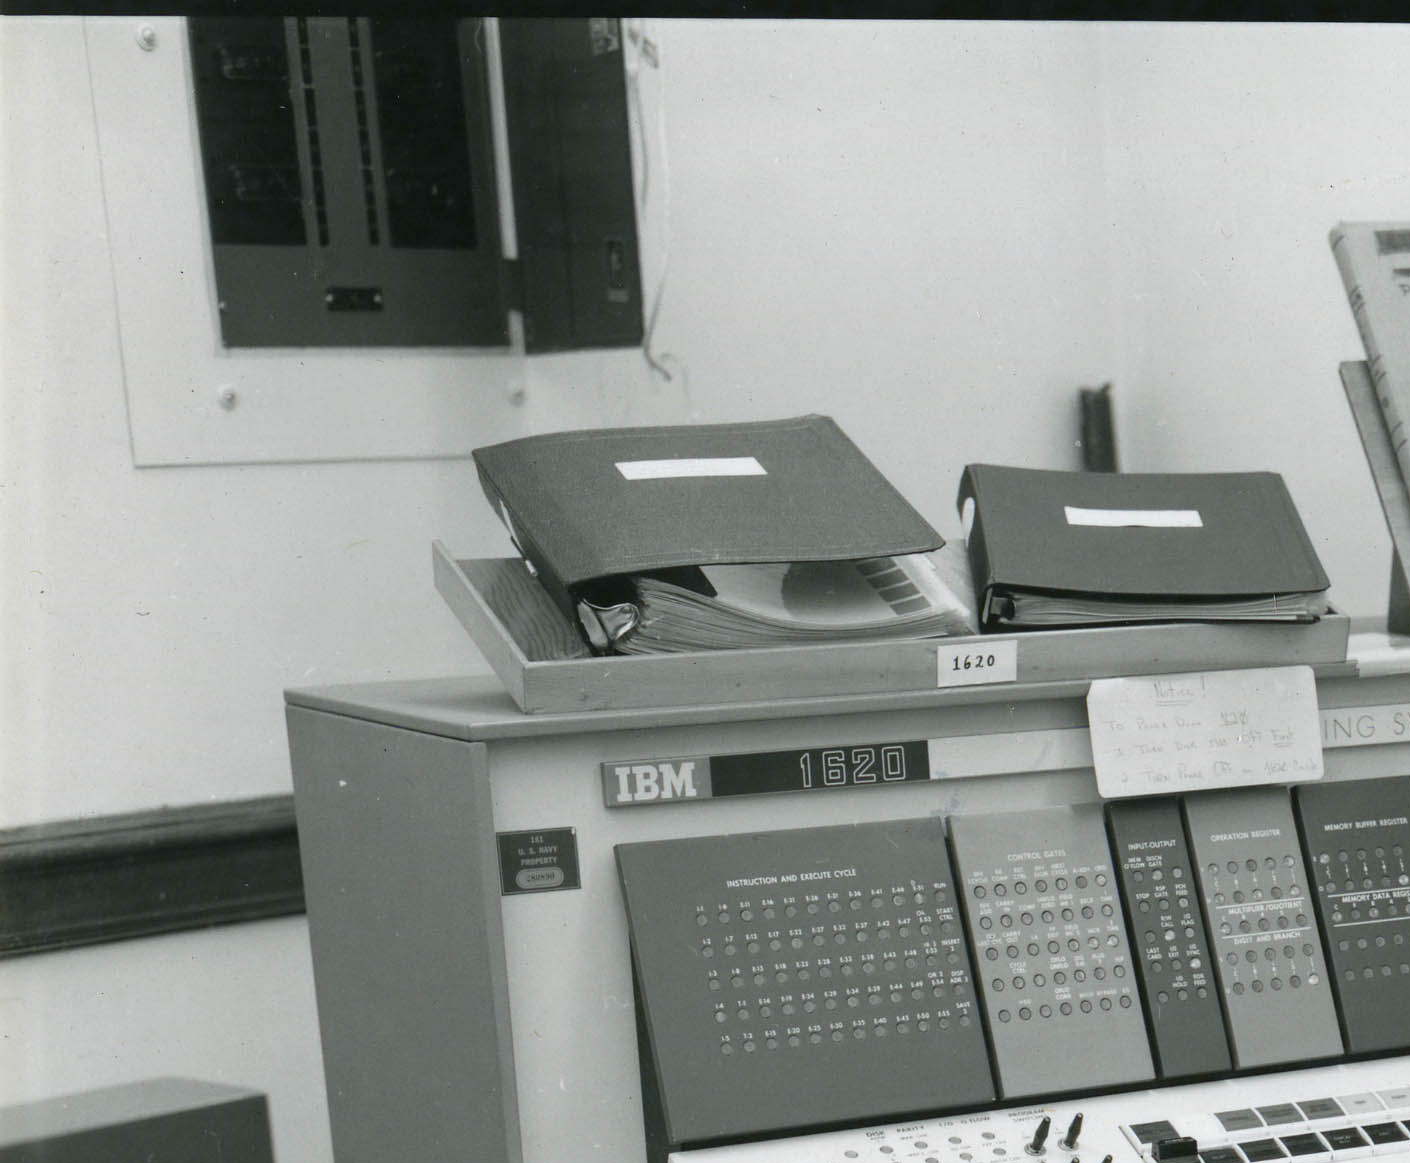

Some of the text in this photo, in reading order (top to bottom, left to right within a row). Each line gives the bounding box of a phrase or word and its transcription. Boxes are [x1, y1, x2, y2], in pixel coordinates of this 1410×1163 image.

[952, 654, 996, 671] 1620
[1324, 714, 1375, 741] ING
[800, 745, 906, 788] 1620
[615, 761, 697, 802] IBM
[1324, 817, 1408, 831] MEMORY BUFFER REGISTER
[1210, 828, 1281, 842] OPERATION REGISTER
[1128, 840, 1176, 851] INPUT-OUTPUT
[1007, 849, 1067, 861] CONTROL GATES
[726, 869, 856, 888] INSTRUCTION AND EXECUTE CYCLE
[1342, 893, 1370, 903] MEMORY
[1373, 891, 1390, 900] DATA
[1256, 933, 1272, 942] AND
[1274, 931, 1302, 941] BRANCH
